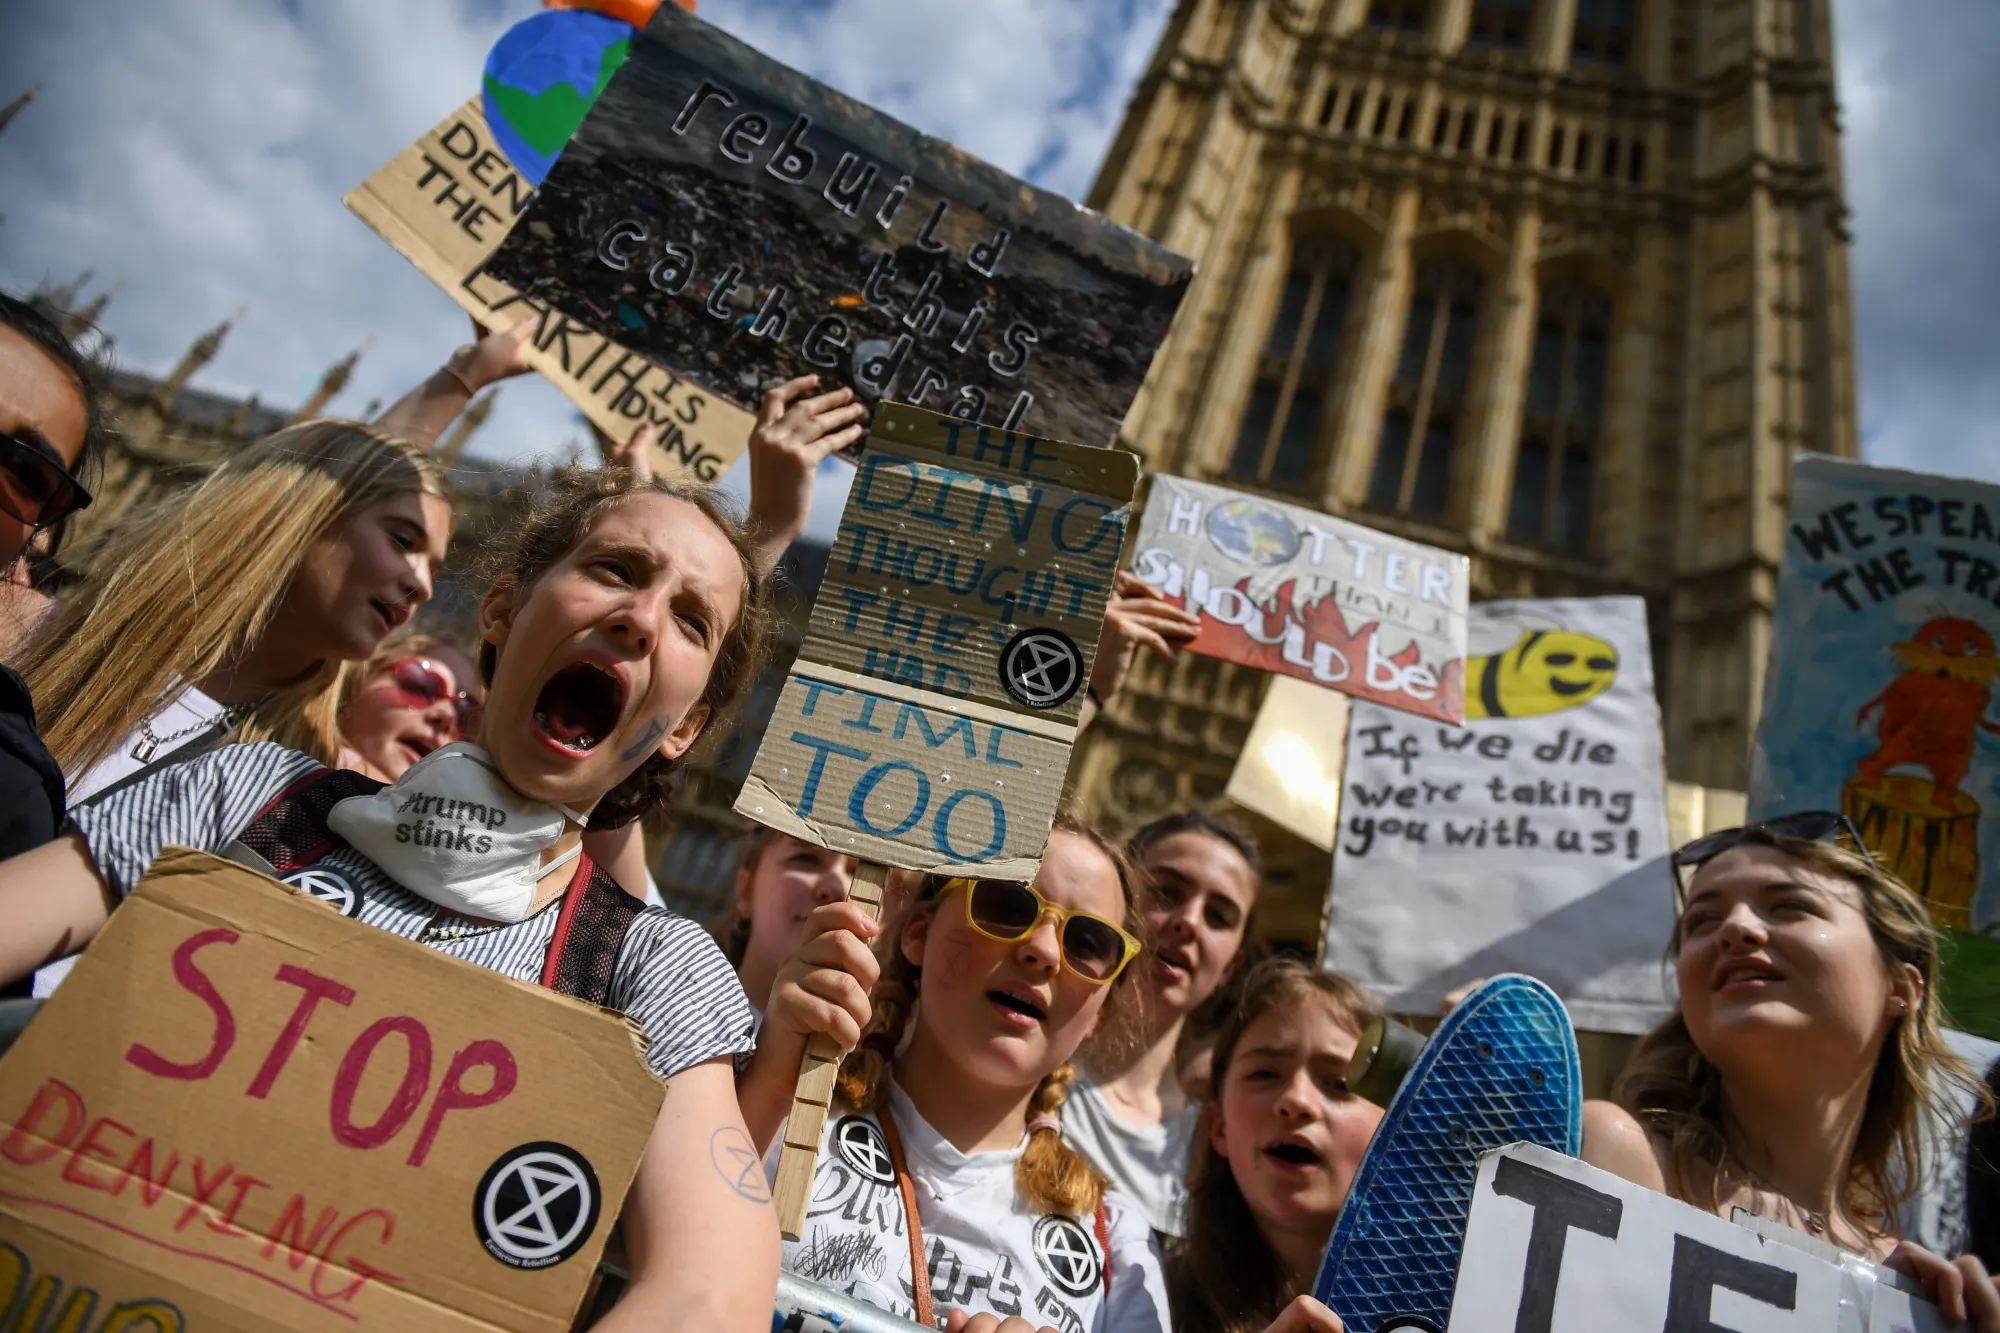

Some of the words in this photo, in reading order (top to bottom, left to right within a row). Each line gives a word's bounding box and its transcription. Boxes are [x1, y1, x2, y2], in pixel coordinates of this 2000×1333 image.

[416, 153, 503, 243] THE
[439, 120, 535, 217] DEN
[671, 79, 1009, 279] rebuild
[597, 218, 1035, 431] cathedral
[861, 250, 1039, 377] this
[616, 387, 723, 484] DYING
[652, 370, 706, 424] IS
[938, 419, 1061, 483] THE
[855, 454, 1131, 569] DINOS
[1791, 502, 1876, 563] WE
[1873, 493, 2000, 546] SPEA
[840, 525, 1101, 624] THOUGHT
[1821, 548, 1927, 614] THE
[1934, 547, 2000, 608] TR
[1133, 547, 1351, 683] SHOULD
[1365, 631, 1438, 701] be
[861, 647, 974, 699] HAD
[794, 675, 1030, 768] TIME
[1358, 724, 1421, 775] If
[1437, 728, 1514, 761] we
[1533, 728, 1618, 766] die
[394, 819, 494, 855] stinks
[397, 791, 507, 831] #trump
[789, 731, 1007, 863] TOO
[1343, 815, 1429, 858] you
[1444, 815, 1540, 850] with
[1555, 827, 1641, 861] us!
[1486, 774, 1635, 826] taking
[125, 928, 518, 1168] STOP
[0, 1077, 406, 1303] DENYING
[484, 1239, 519, 1267] Extinction
[521, 1255, 560, 1268] Rebellion
